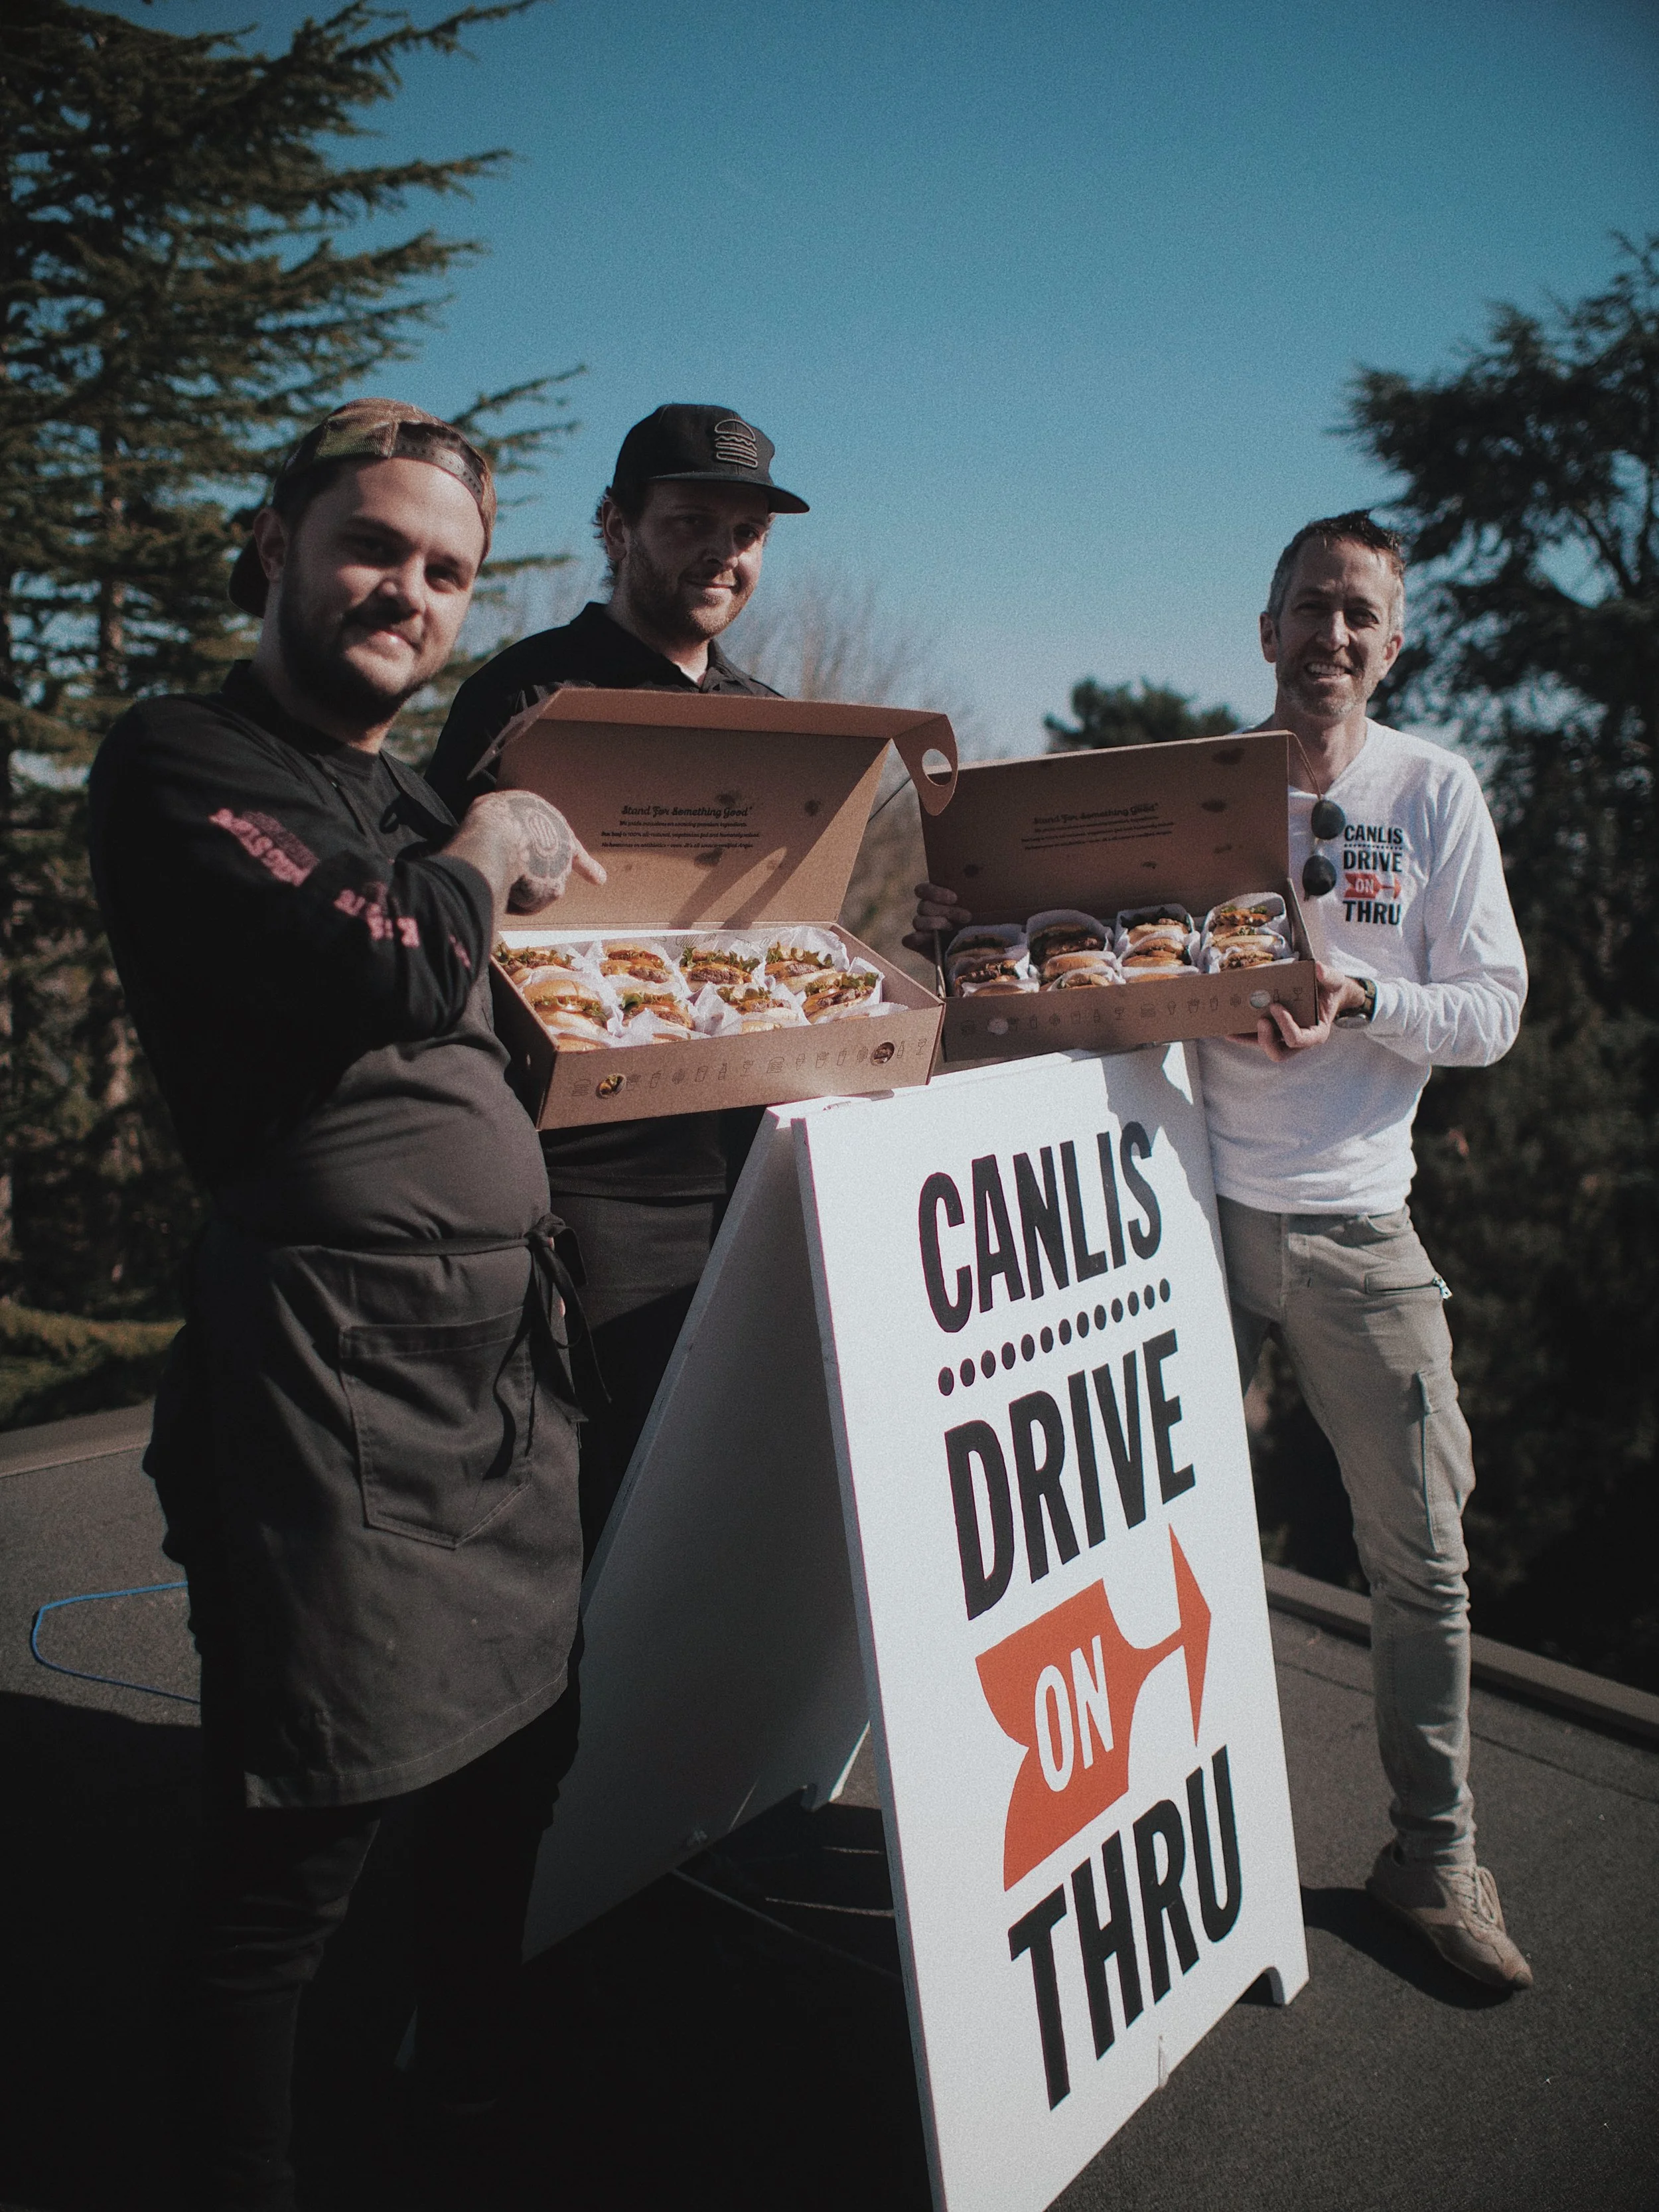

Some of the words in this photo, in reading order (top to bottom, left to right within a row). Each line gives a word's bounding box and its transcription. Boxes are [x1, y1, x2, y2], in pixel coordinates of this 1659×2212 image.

[621, 805, 650, 815] Stand
[652, 806, 670, 818] For
[671, 806, 722, 819] Something
[1344, 824, 1404, 844] CANLIS
[1343, 849, 1403, 873] DRIVE
[1354, 877, 1375, 894] ON
[1342, 900, 1402, 925] THRU
[918, 1121, 1162, 1333] CANLIS
[944, 1329, 1196, 1621] DRIVE
[1034, 1635, 1114, 1792] ON
[1007, 1744, 1243, 2111] THRU
